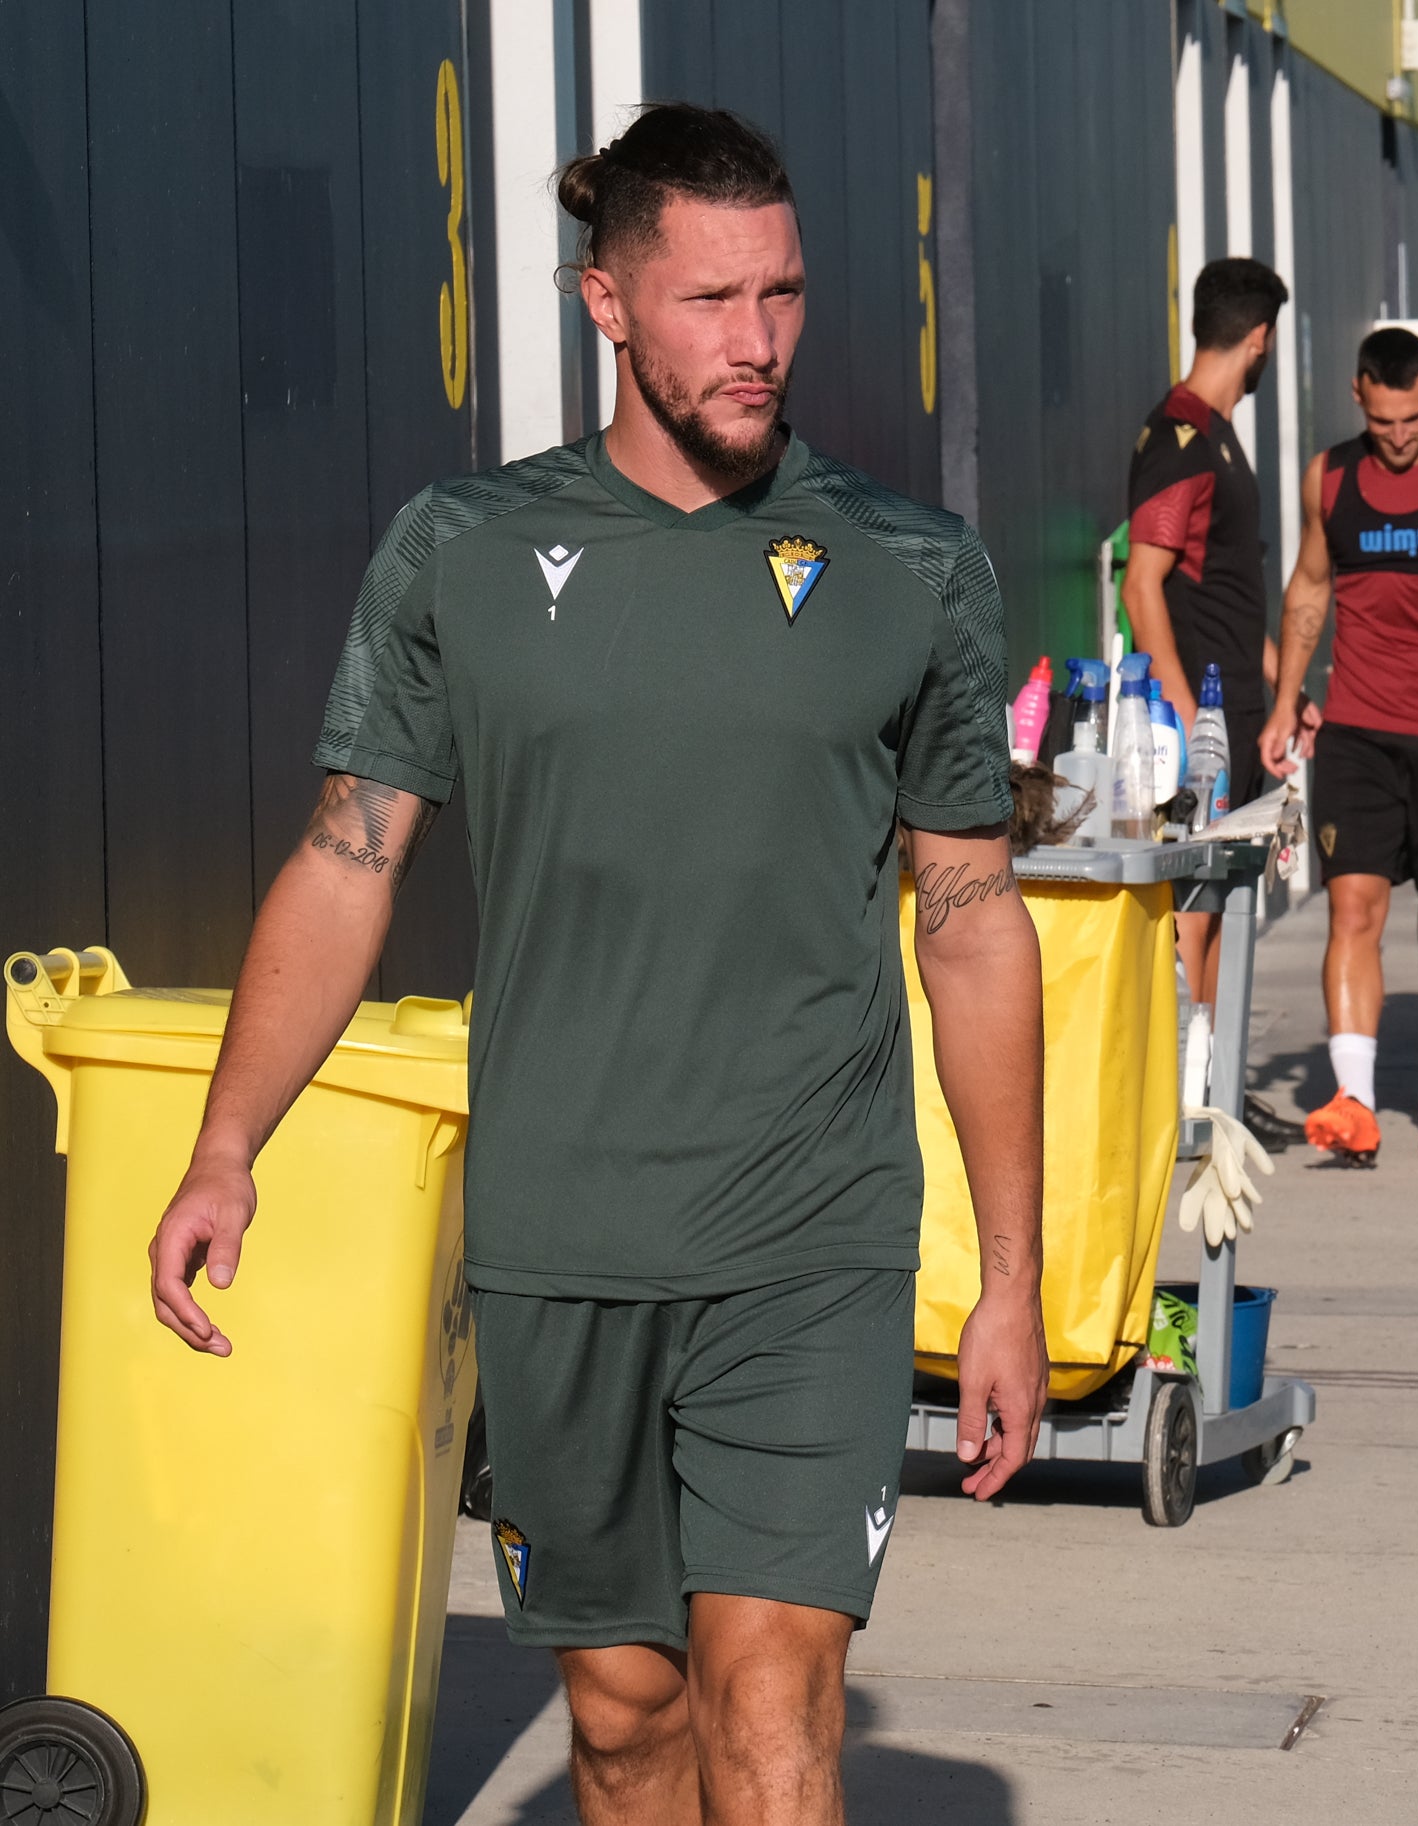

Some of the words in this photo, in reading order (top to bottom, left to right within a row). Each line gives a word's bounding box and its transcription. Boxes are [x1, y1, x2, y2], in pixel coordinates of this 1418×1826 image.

[436, 59, 467, 410] 3
[548, 605, 556, 621] 1
[311, 832, 389, 873] 06-12-2018
[881, 1485, 887, 1502] 1
